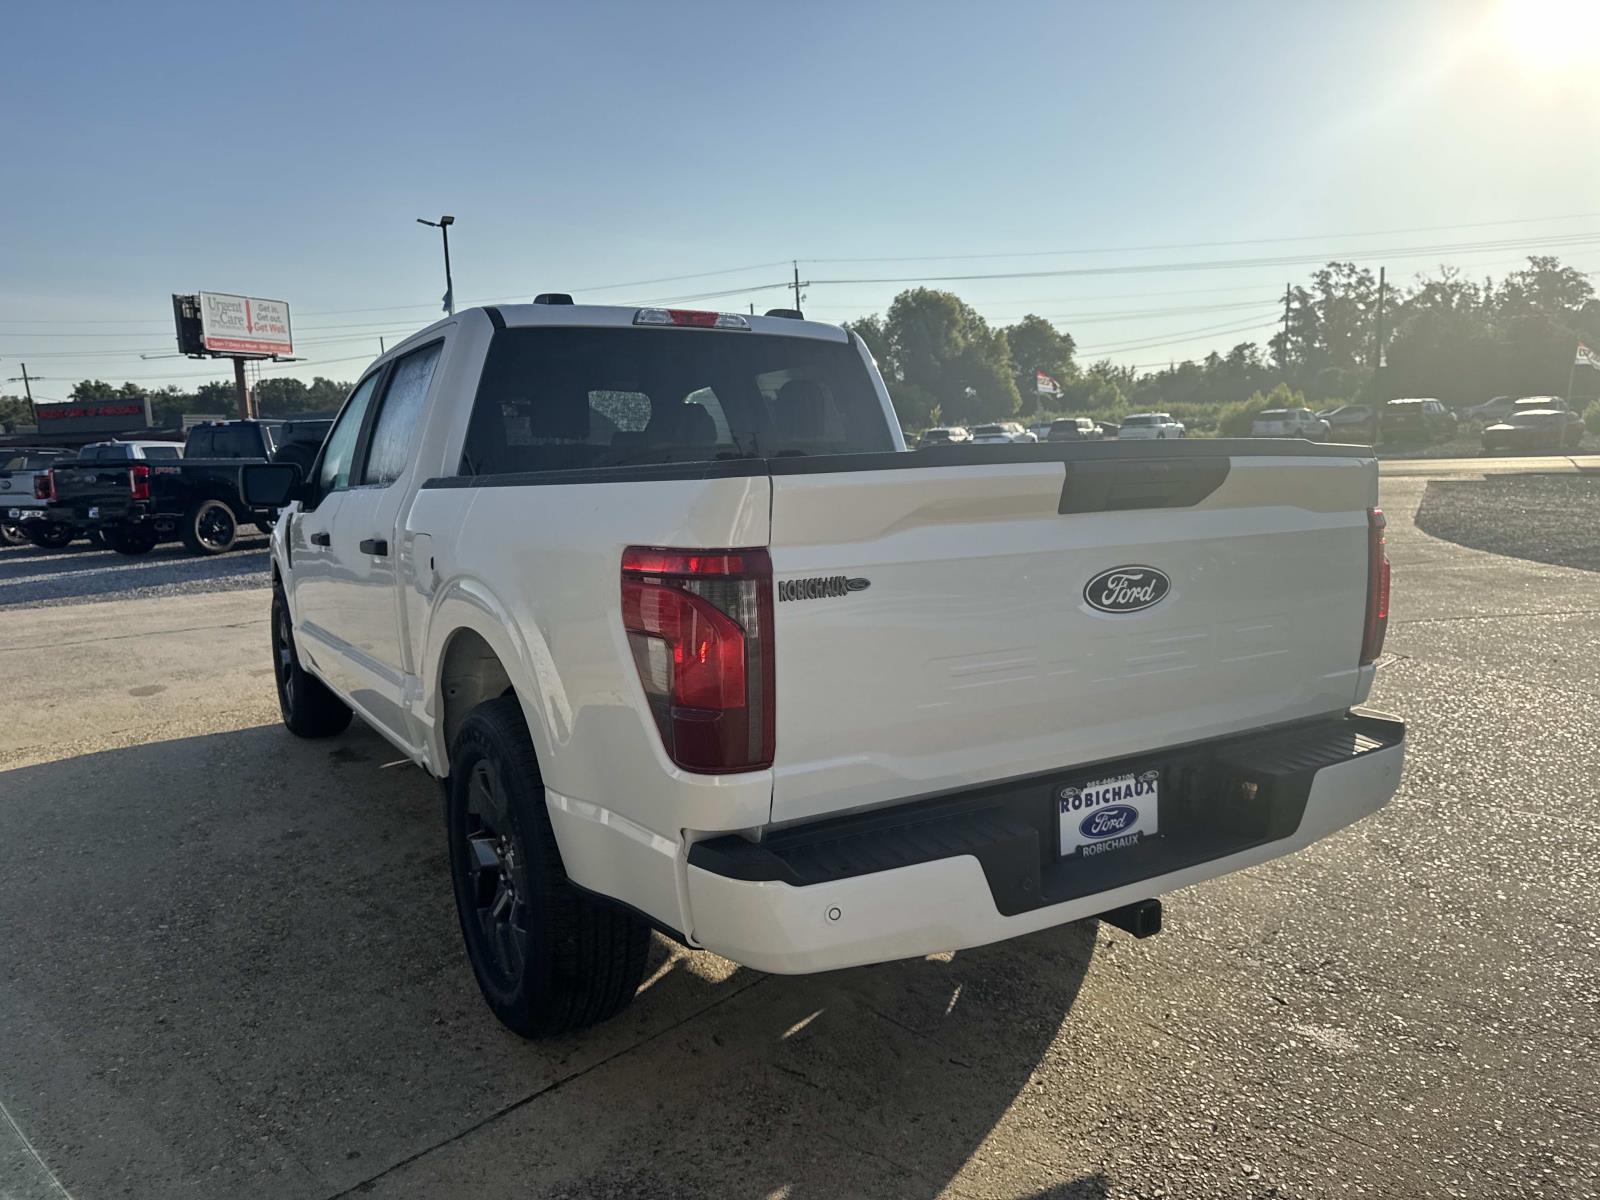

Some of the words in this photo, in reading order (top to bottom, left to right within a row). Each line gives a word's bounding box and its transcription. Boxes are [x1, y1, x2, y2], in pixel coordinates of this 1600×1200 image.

[207, 297, 243, 313] Urgent
[258, 304, 270, 312] Get
[219, 311, 245, 325] Care
[256, 312, 269, 321] Get
[254, 322, 269, 332] Get
[778, 575, 848, 602] ROBICHAUX
[1101, 574, 1156, 605] Ford
[1060, 780, 1156, 814] ROBICHAUX
[1091, 810, 1127, 834] Ford
[1082, 834, 1139, 858] ROBICHAUX
